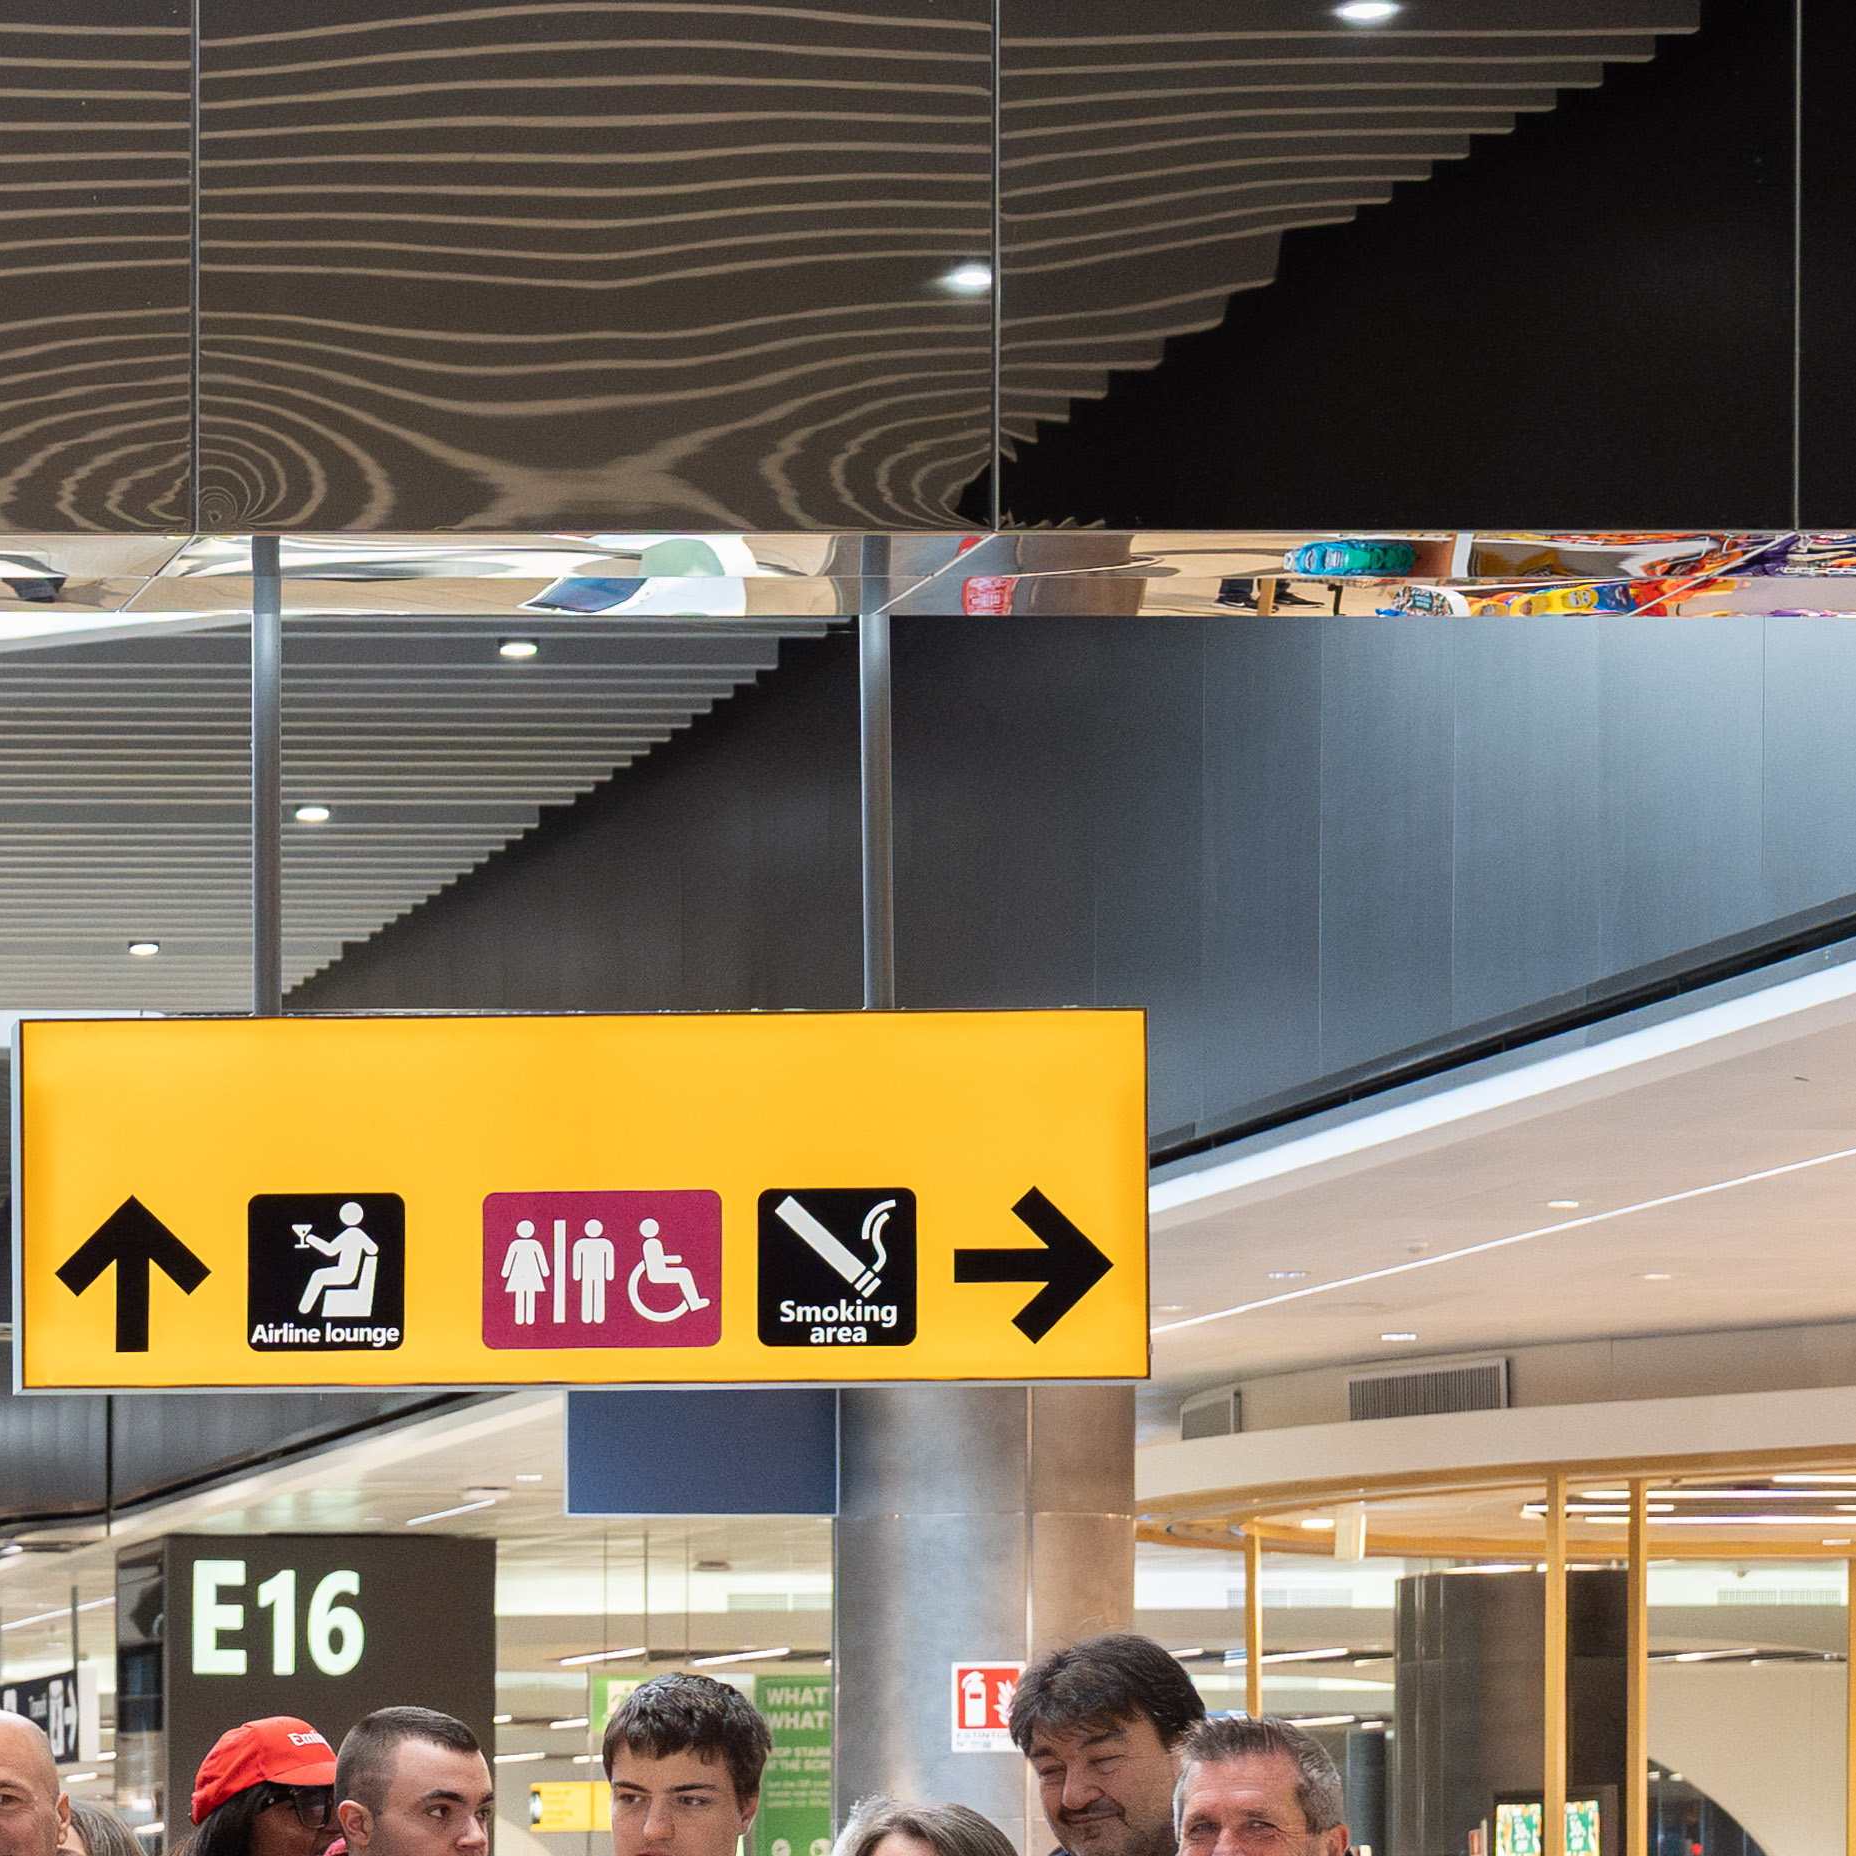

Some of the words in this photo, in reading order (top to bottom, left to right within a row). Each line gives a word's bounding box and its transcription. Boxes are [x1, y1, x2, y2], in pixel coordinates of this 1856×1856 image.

[779, 1299, 898, 1328] Smoking
[250, 1323, 319, 1344] Airline
[324, 1323, 400, 1349] lounge
[809, 1323, 867, 1344] area
[193, 1560, 364, 1675] E16
